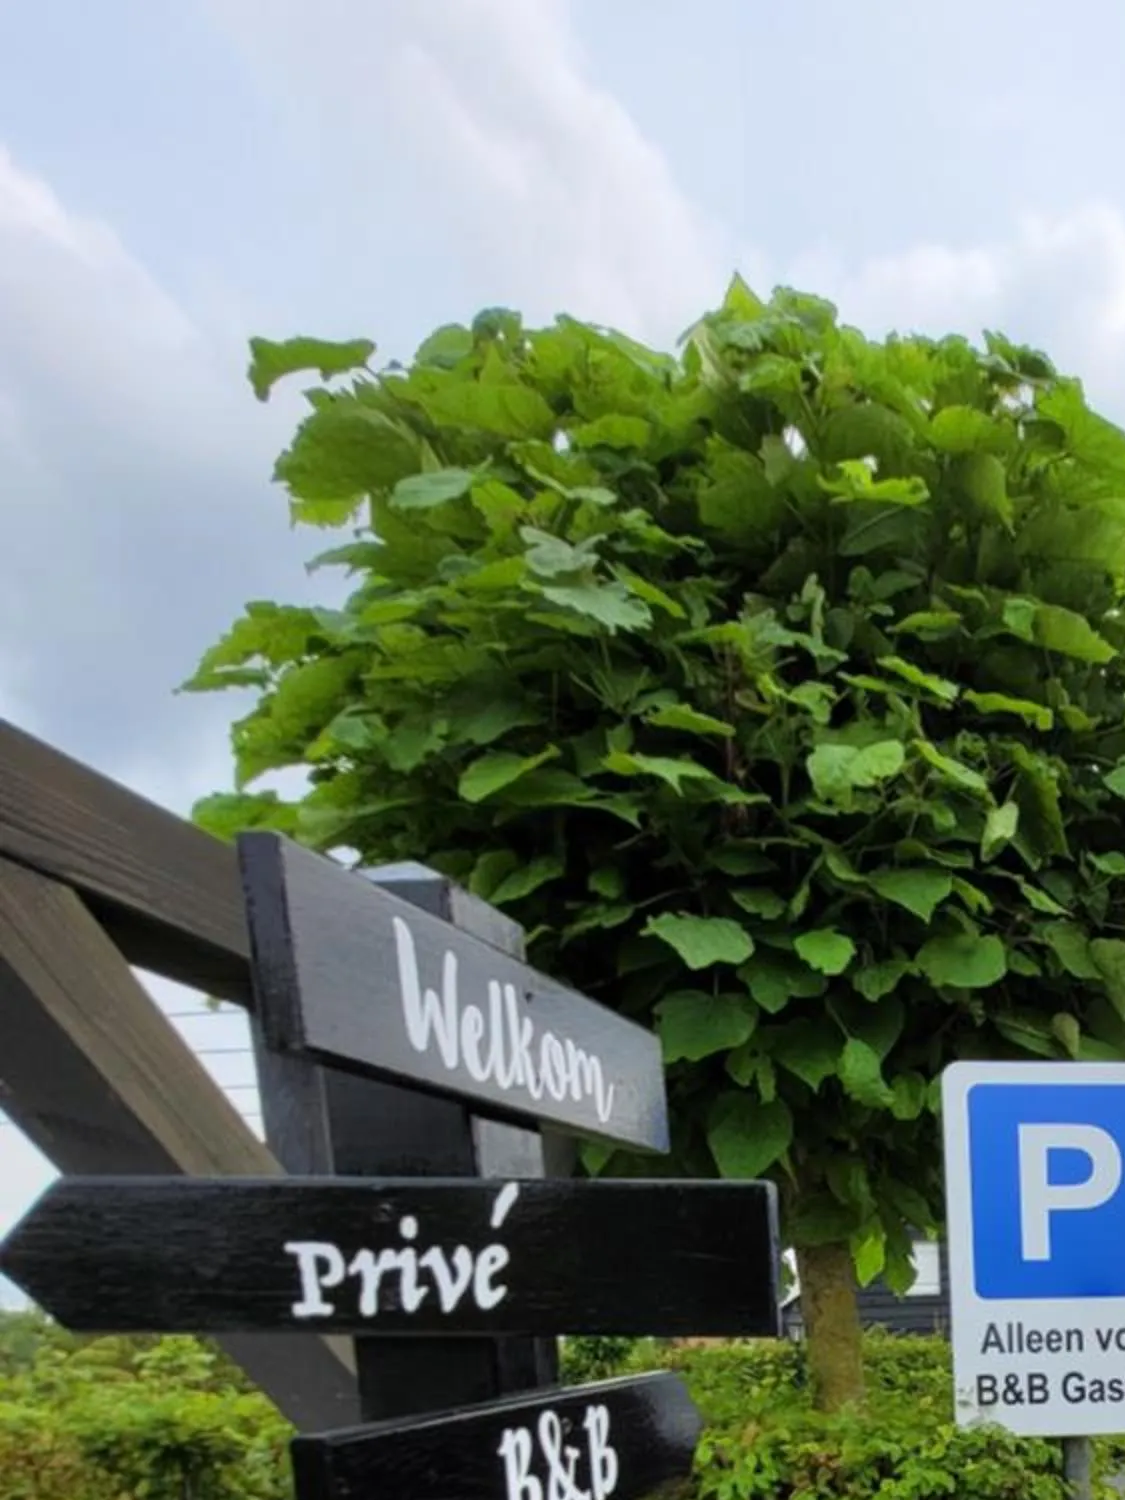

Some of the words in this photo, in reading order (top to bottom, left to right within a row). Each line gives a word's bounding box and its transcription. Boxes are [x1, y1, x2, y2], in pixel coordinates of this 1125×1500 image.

[394, 916, 614, 1122] Welkom
[1017, 1123, 1123, 1261] P
[980, 1323, 1084, 1355] Alleen
[975, 1372, 1050, 1407] B&B
